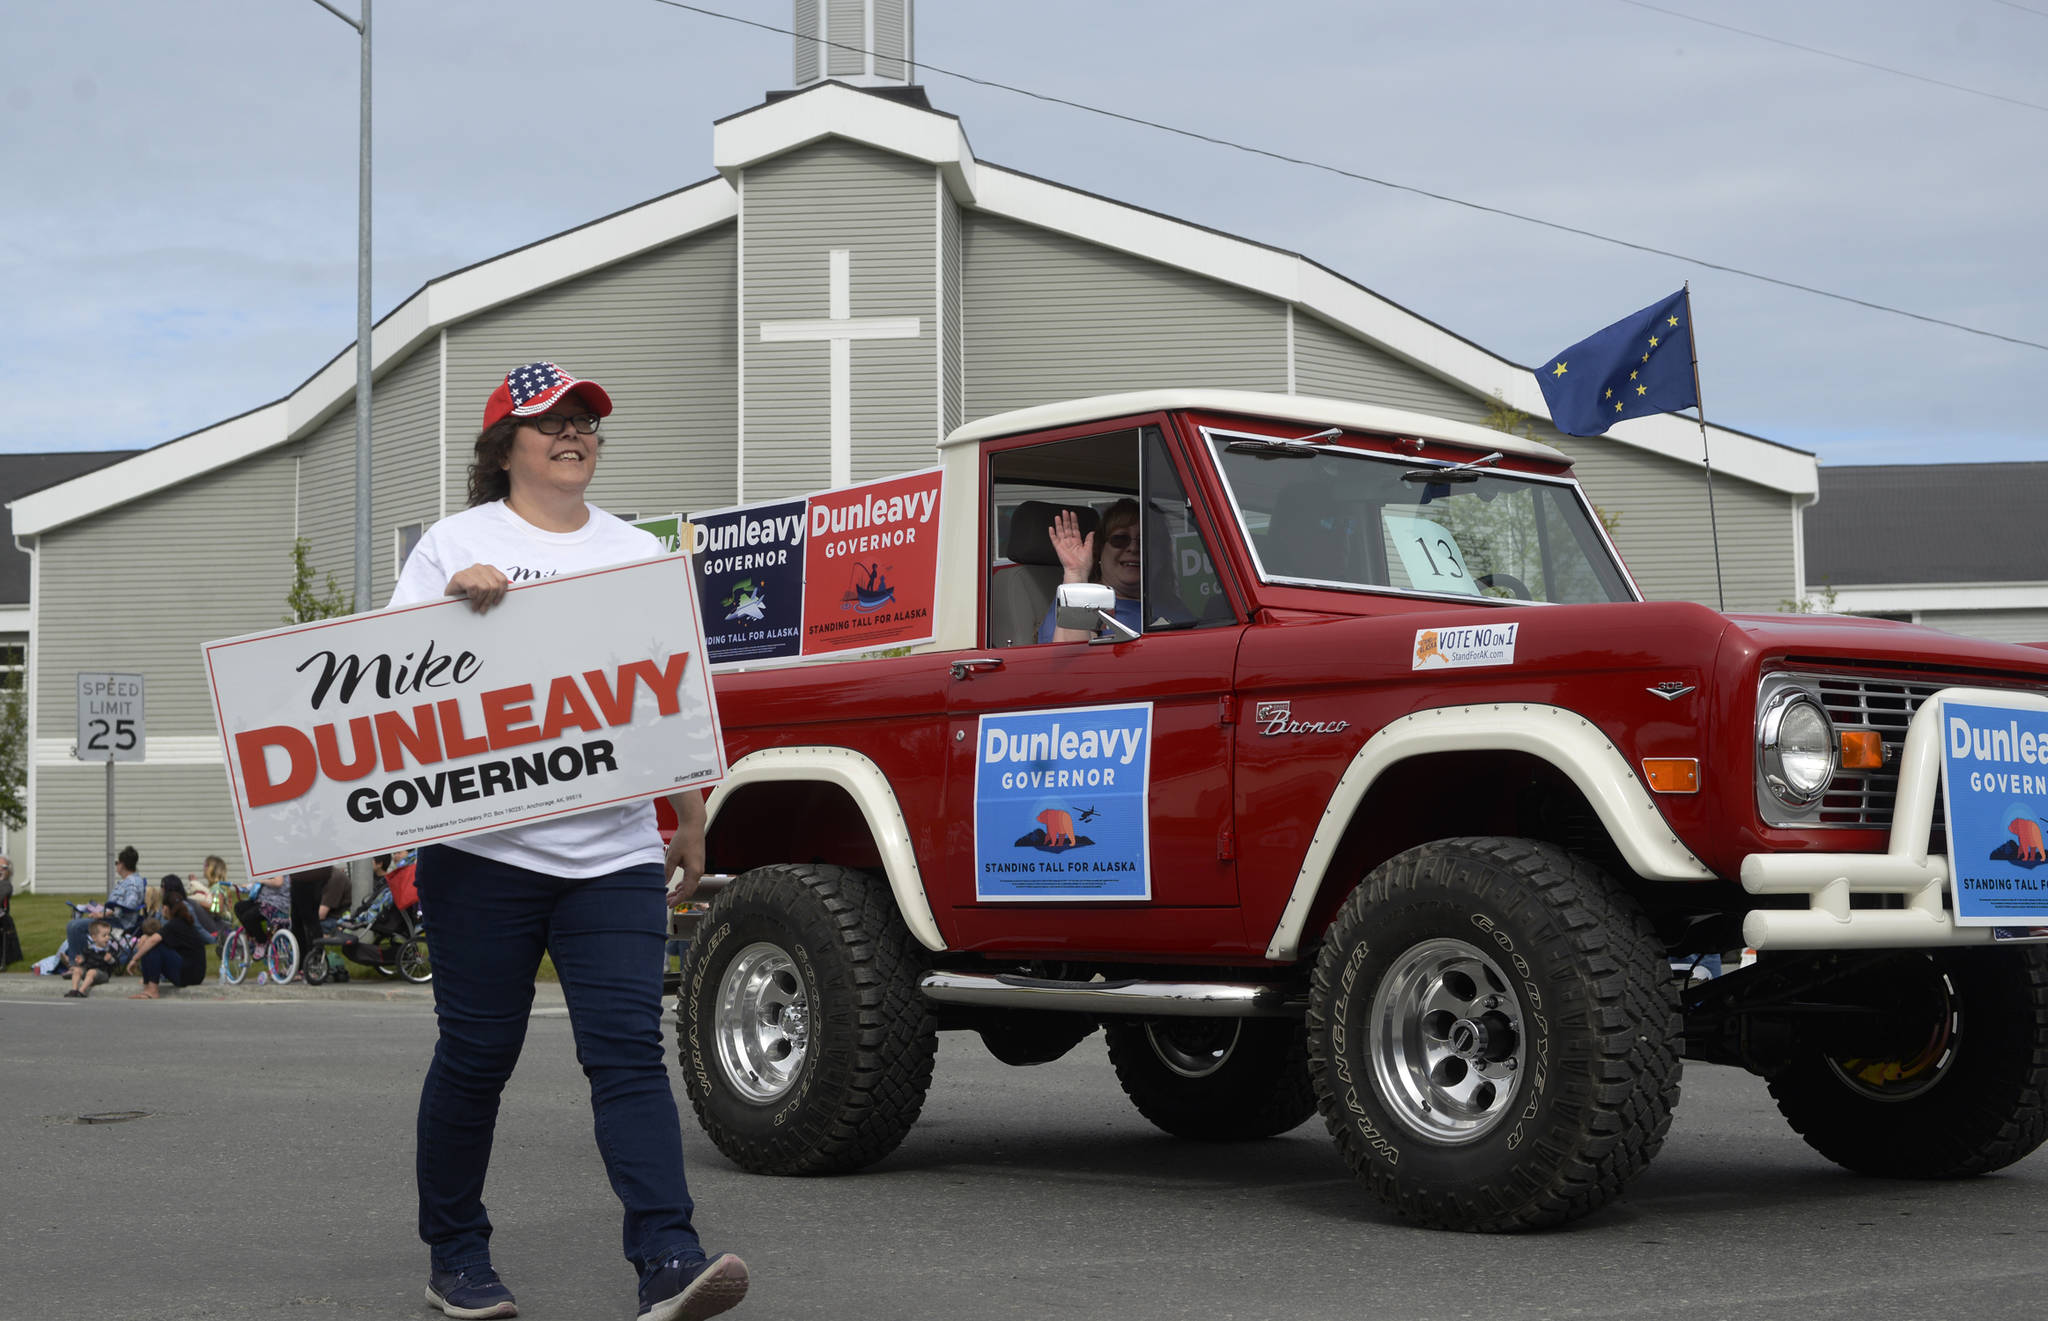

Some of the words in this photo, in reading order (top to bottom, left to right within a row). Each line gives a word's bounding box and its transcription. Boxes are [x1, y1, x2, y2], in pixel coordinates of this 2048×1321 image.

[811, 489, 938, 537] Dunleavy
[693, 513, 806, 554] Dunleavy
[825, 527, 916, 559] GOVERNOR
[704, 549, 787, 575] GOVERNOR
[1416, 537, 1463, 578] 13
[728, 633, 746, 643] TALL
[749, 631, 764, 640] FOR
[767, 627, 799, 639] ALASKA
[809, 622, 849, 635] STANDING
[852, 617, 872, 629] TALL
[874, 614, 891, 625] FOR
[894, 608, 927, 621] ALASKA
[1439, 630, 1473, 650] VOTE
[1474, 628, 1492, 648] NO
[1505, 624, 1514, 645] 1
[1451, 650, 1504, 662] StandForAK.com
[82, 682, 139, 697] SPEED
[296, 640, 484, 710] Mike
[90, 701, 132, 715] LIMIT
[1259, 709, 1350, 736] Bronco
[88, 719, 137, 751] 25
[235, 652, 690, 808] DUNLEAVY
[985, 723, 1143, 765] Dunleavy
[347, 739, 618, 823] GOVERNOR
[1002, 768, 1116, 790] GOVERNOR
[985, 862, 1036, 873] STANDING
[1038, 862, 1065, 872] TALL
[1068, 862, 1089, 872] FOR
[1093, 861, 1137, 872] ALASKA
[1963, 878, 2012, 890] STANDING
[2014, 879, 2038, 890] TALL
[689, 922, 731, 1096] WRANGLER
[1333, 941, 1399, 1165] WRANGLER
